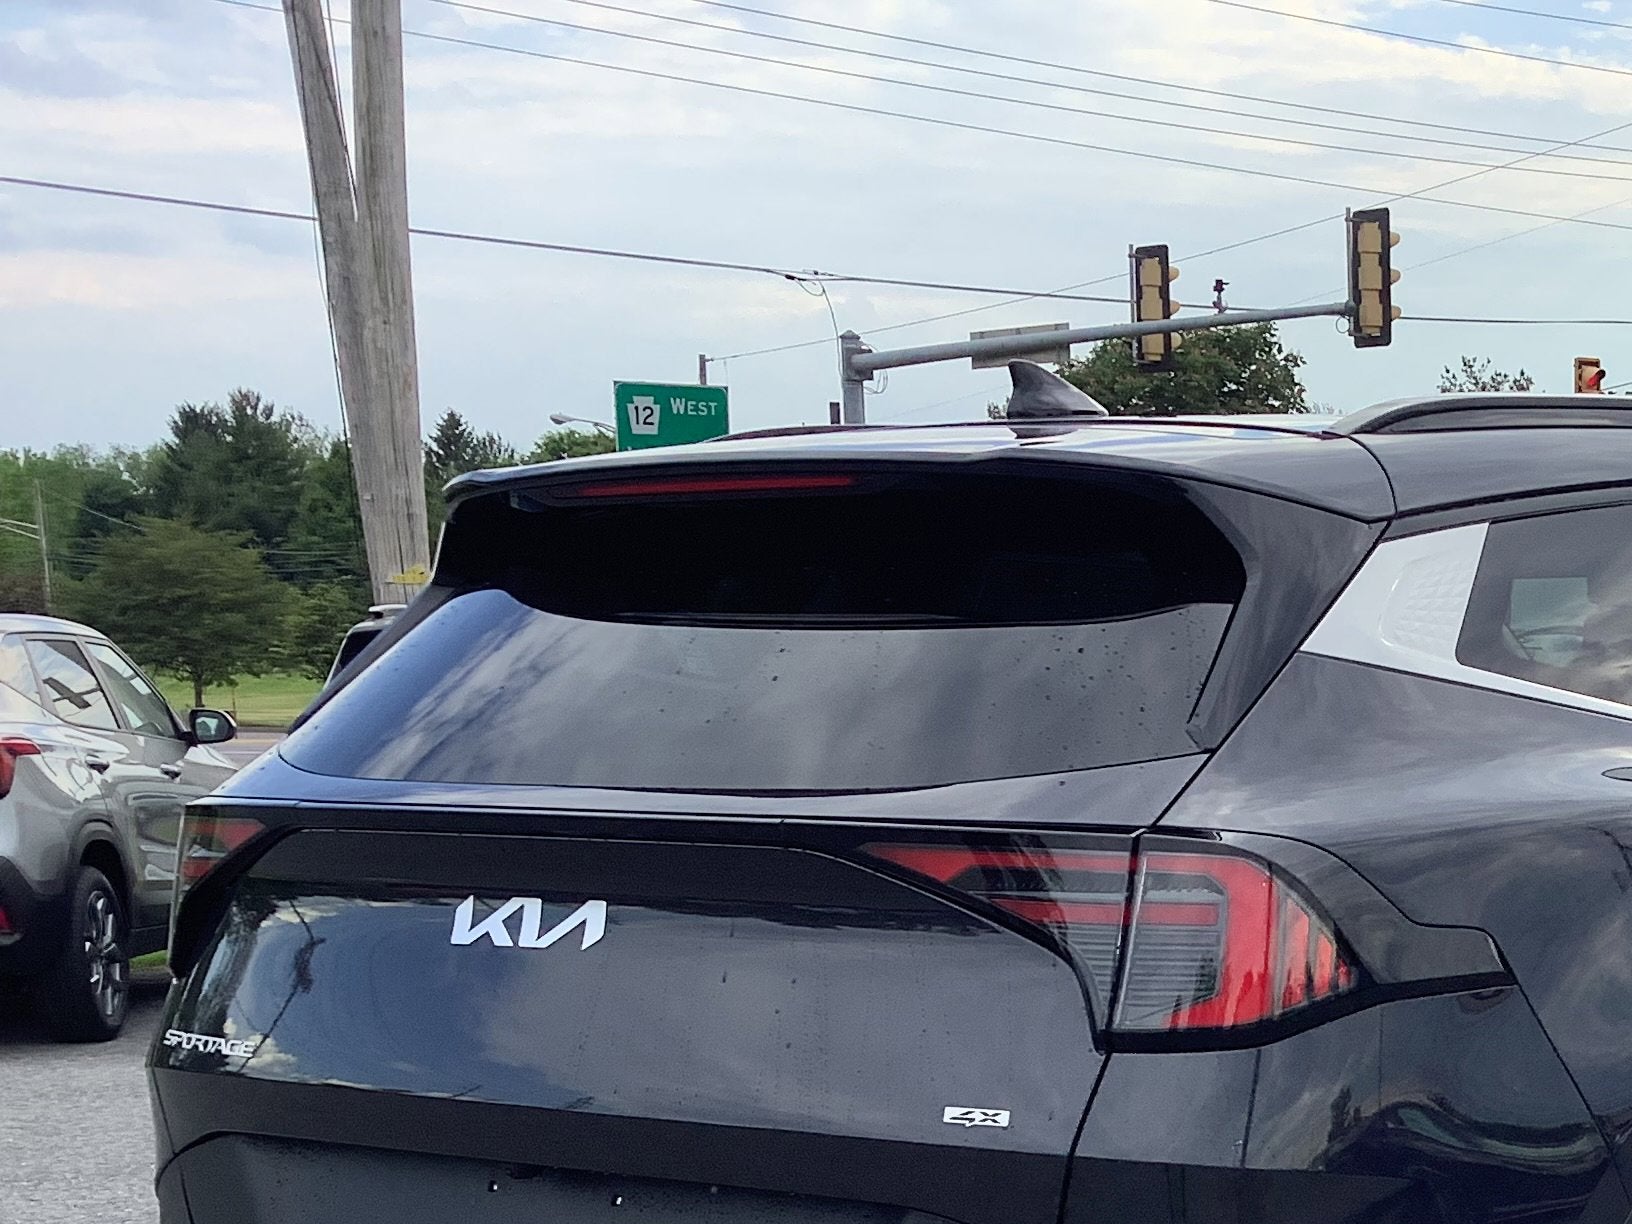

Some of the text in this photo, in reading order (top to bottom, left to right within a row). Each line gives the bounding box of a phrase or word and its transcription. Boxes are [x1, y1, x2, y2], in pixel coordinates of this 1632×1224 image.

[634, 397, 718, 426] 12 WEST
[450, 895, 607, 951] KIA
[163, 1028, 257, 1058] SPORTAGE
